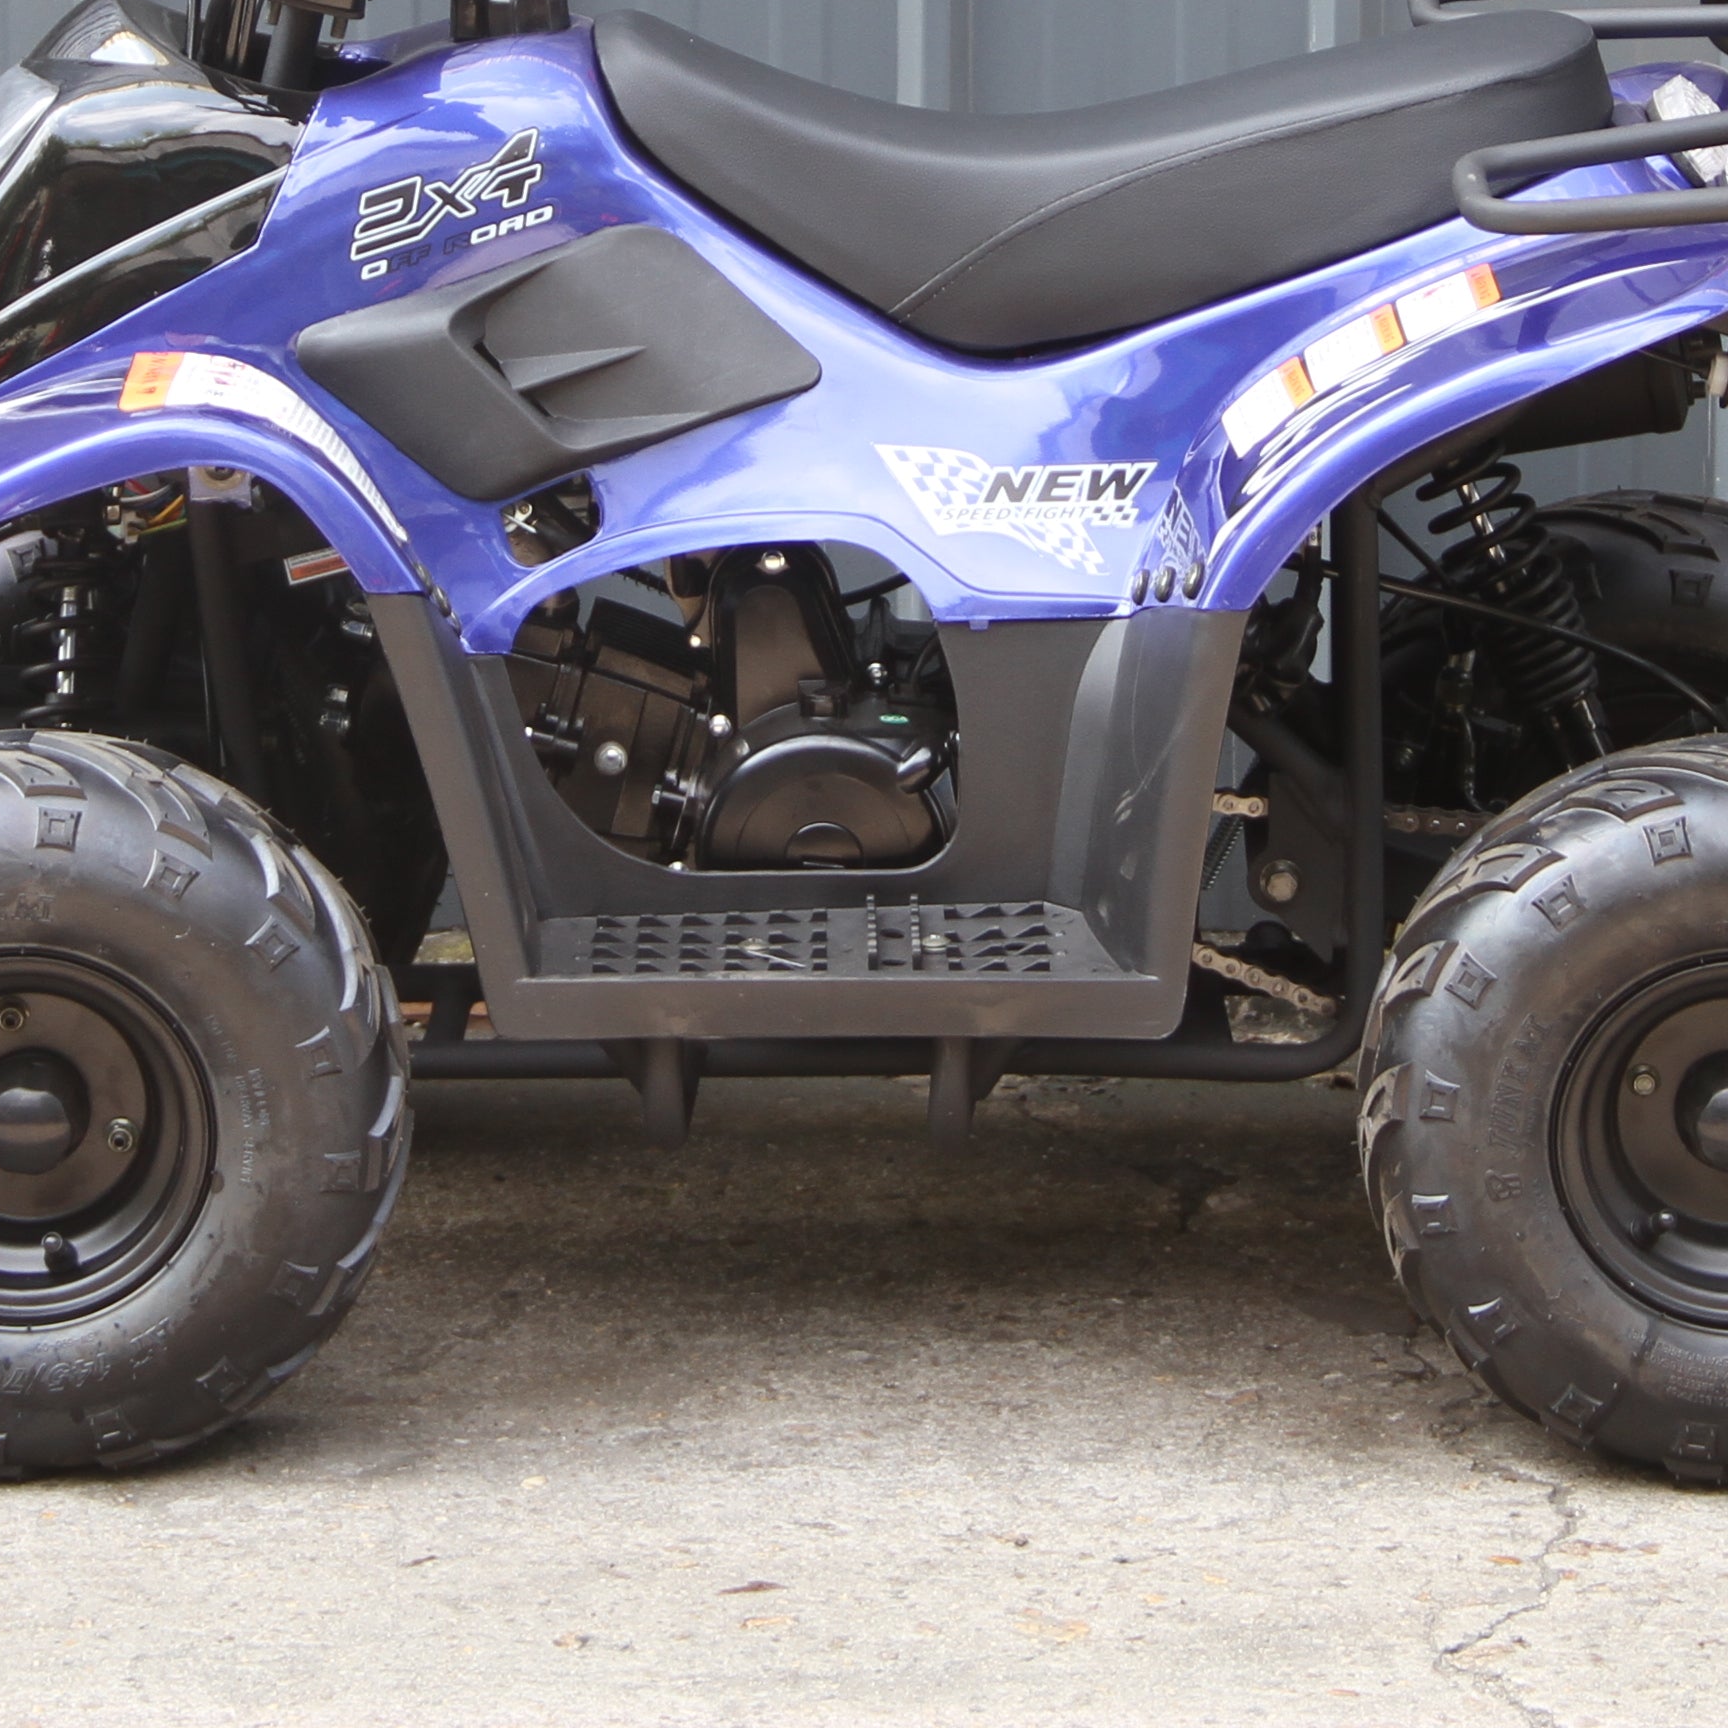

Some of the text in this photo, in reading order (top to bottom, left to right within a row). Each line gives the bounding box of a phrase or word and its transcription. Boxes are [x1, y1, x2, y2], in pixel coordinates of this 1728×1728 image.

[361, 205, 553, 280] OFF ROAD
[982, 466, 1152, 503] NEW
[943, 506, 1090, 521] SPEED FIGHT
